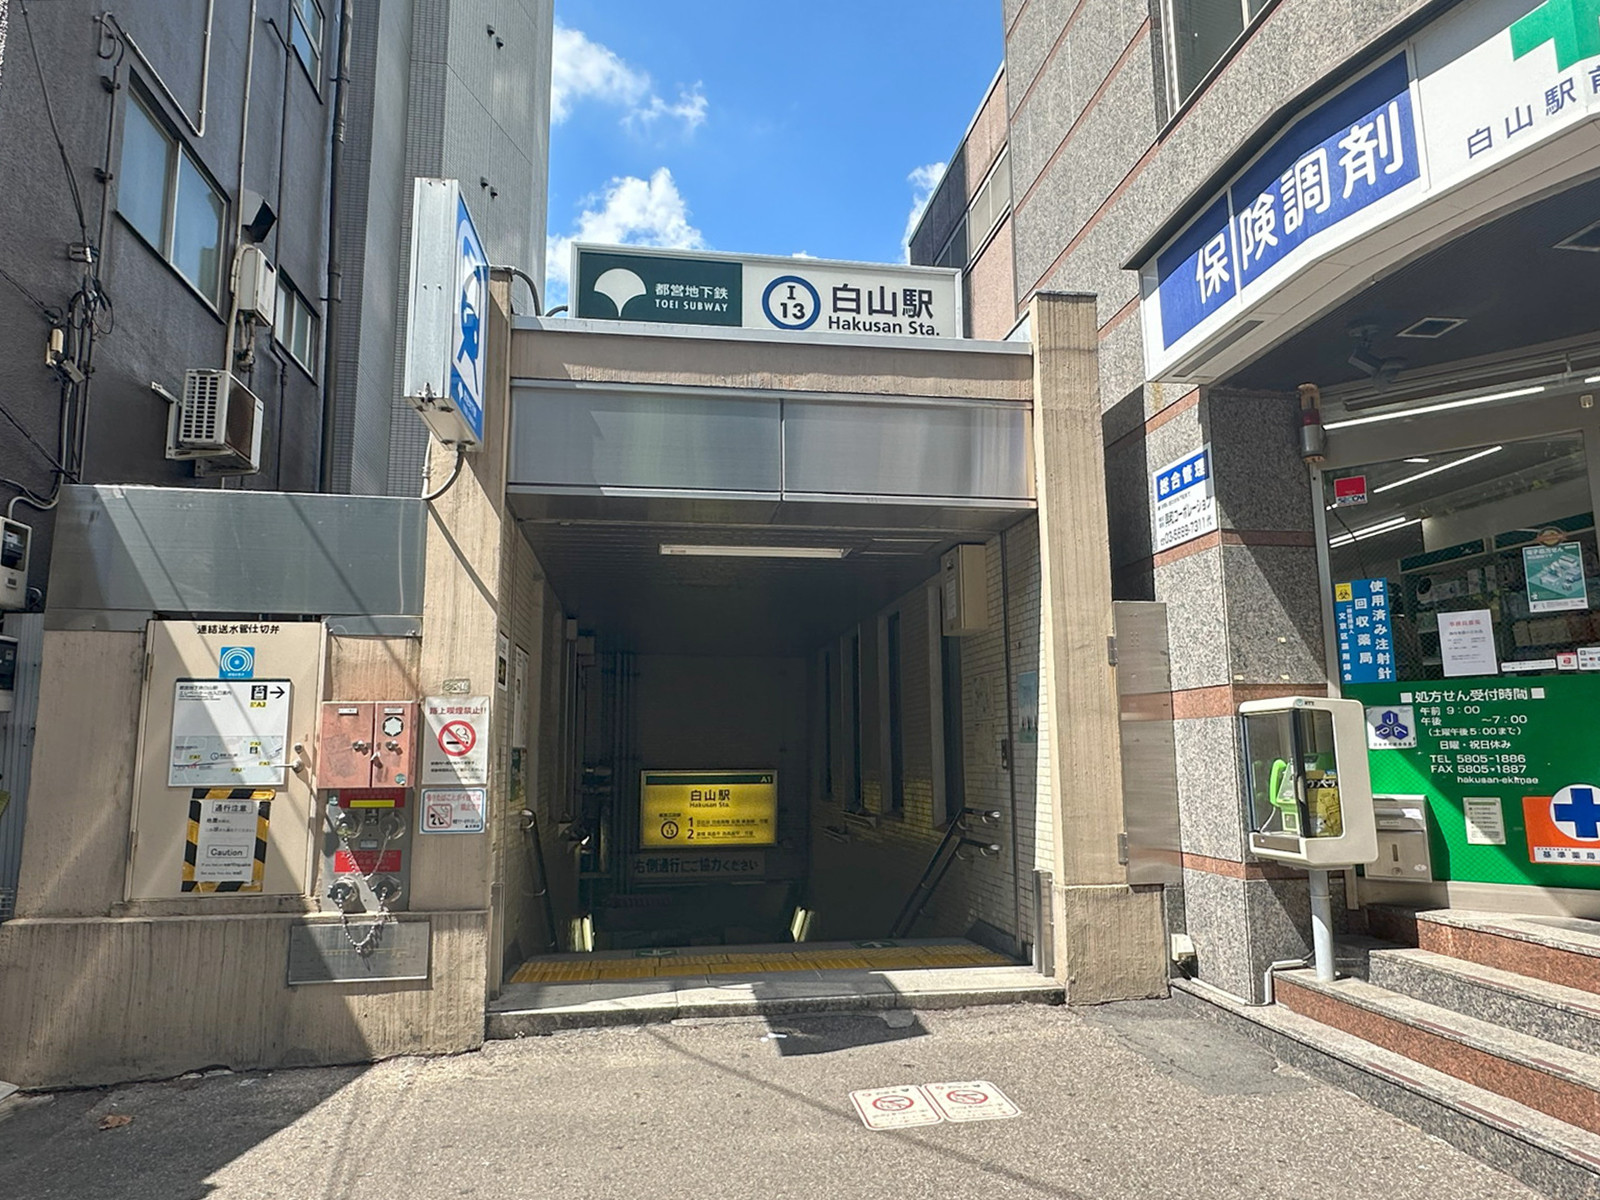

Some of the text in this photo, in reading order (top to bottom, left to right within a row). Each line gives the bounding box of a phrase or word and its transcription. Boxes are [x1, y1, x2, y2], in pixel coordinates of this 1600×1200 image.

[1195, 101, 1404, 304] 保険調剤
[655, 283, 729, 300] 都営地下鉄
[787, 286, 796, 300] I
[655, 300, 728, 313] TOEI SUBWAY
[832, 283, 934, 319] 白山駅
[780, 302, 805, 320] 13
[828, 316, 940, 336] Hakusan Sta.
[197, 624, 280, 635] 連結送水管仕切弁
[1355, 598, 1373, 664] 回収薬局
[1370, 580, 1392, 679] 使用済み注射針
[1415, 687, 1528, 703] 処方せん受付時間
[1420, 707, 1441, 716] 午前
[1421, 717, 1442, 726] 午後
[1429, 754, 1526, 763] TEL 5805-1886
[1431, 765, 1527, 774] FAX 5805-1887
[690, 789, 730, 801] 白山駅
[215, 804, 247, 812] 通行注意
[688, 817, 693, 827] 1
[687, 829, 694, 839] 2
[210, 848, 243, 856] Caution
[635, 858, 759, 873] 右側通行にご協力ください
